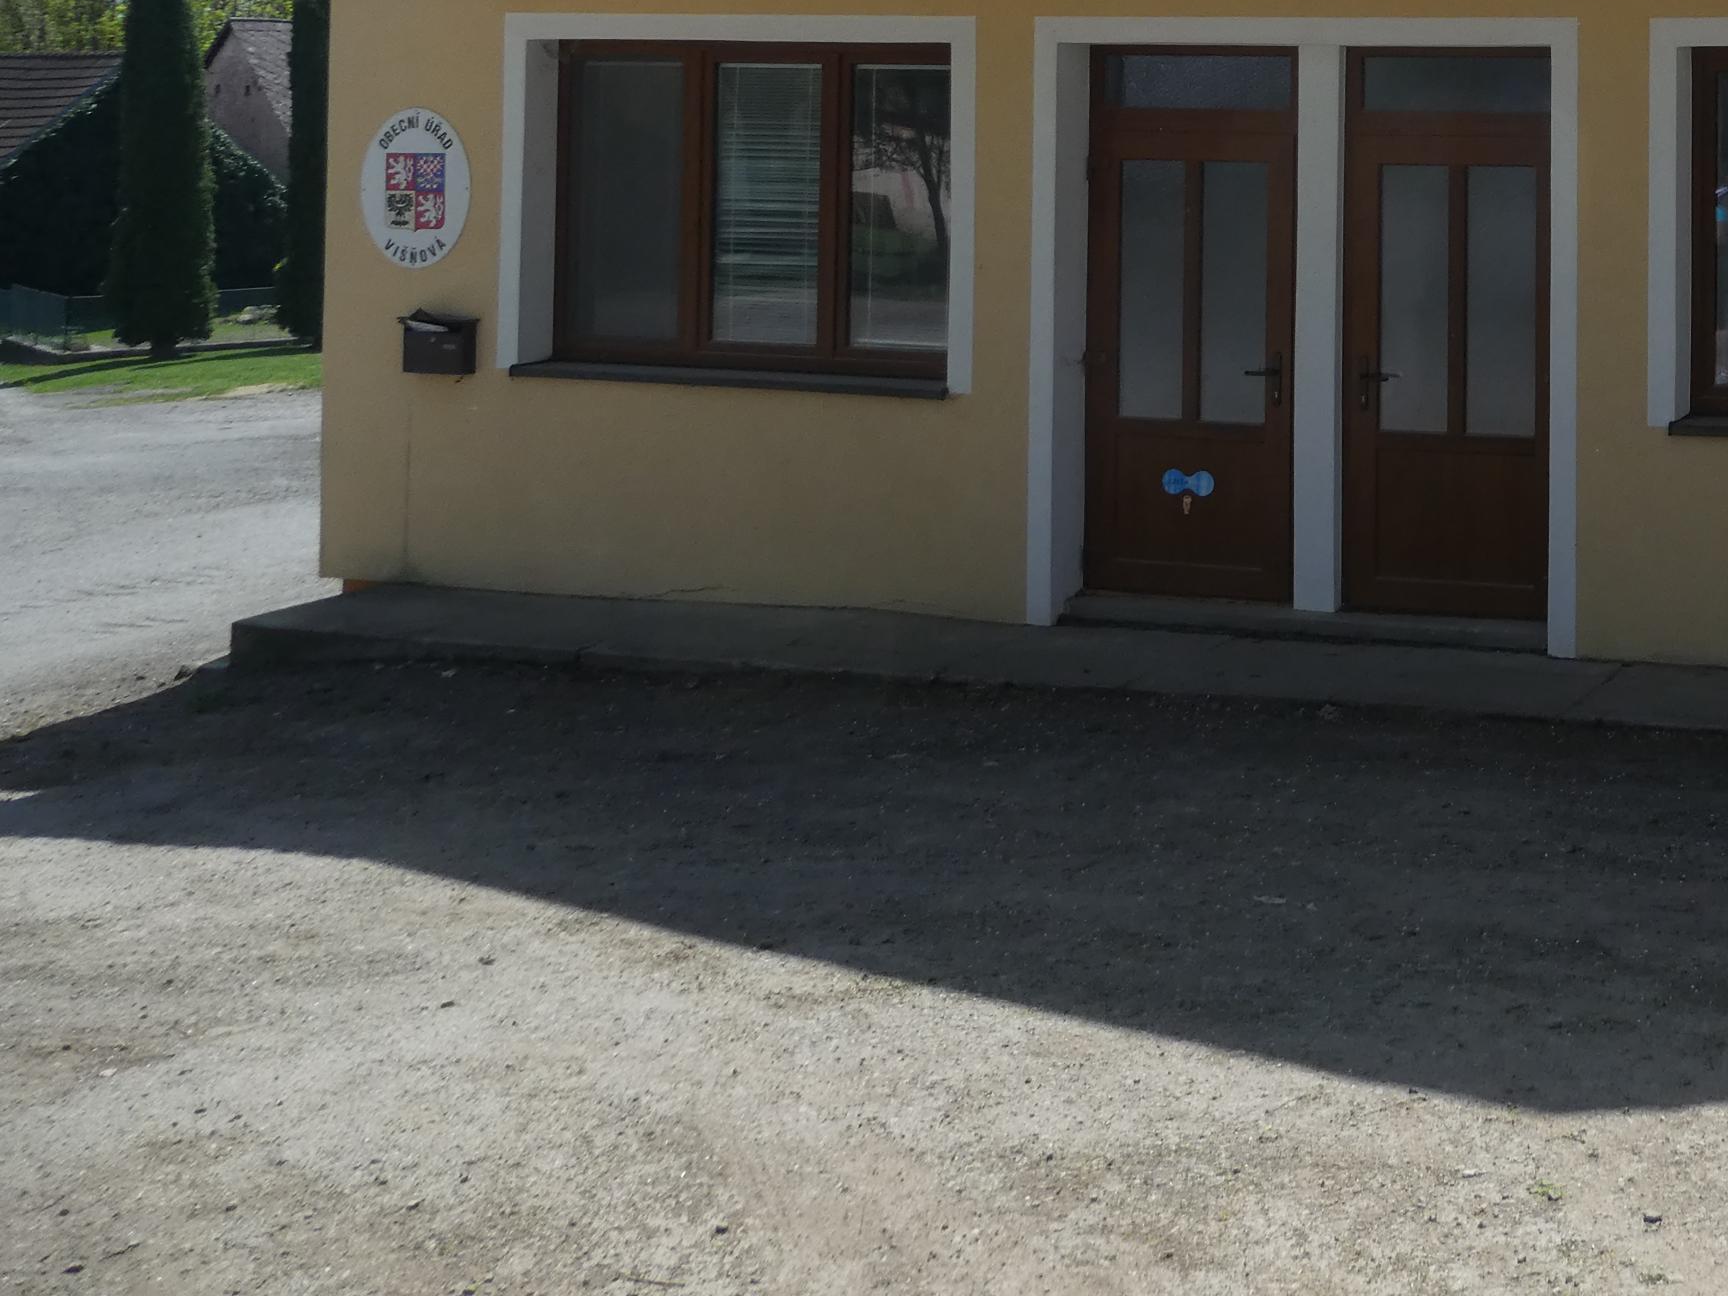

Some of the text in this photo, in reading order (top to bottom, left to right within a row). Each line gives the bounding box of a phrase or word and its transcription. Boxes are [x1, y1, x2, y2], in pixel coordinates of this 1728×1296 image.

[379, 112, 454, 150] OBECNÍ ÚŘAD
[384, 235, 447, 266] VIŠŇOVÁ
